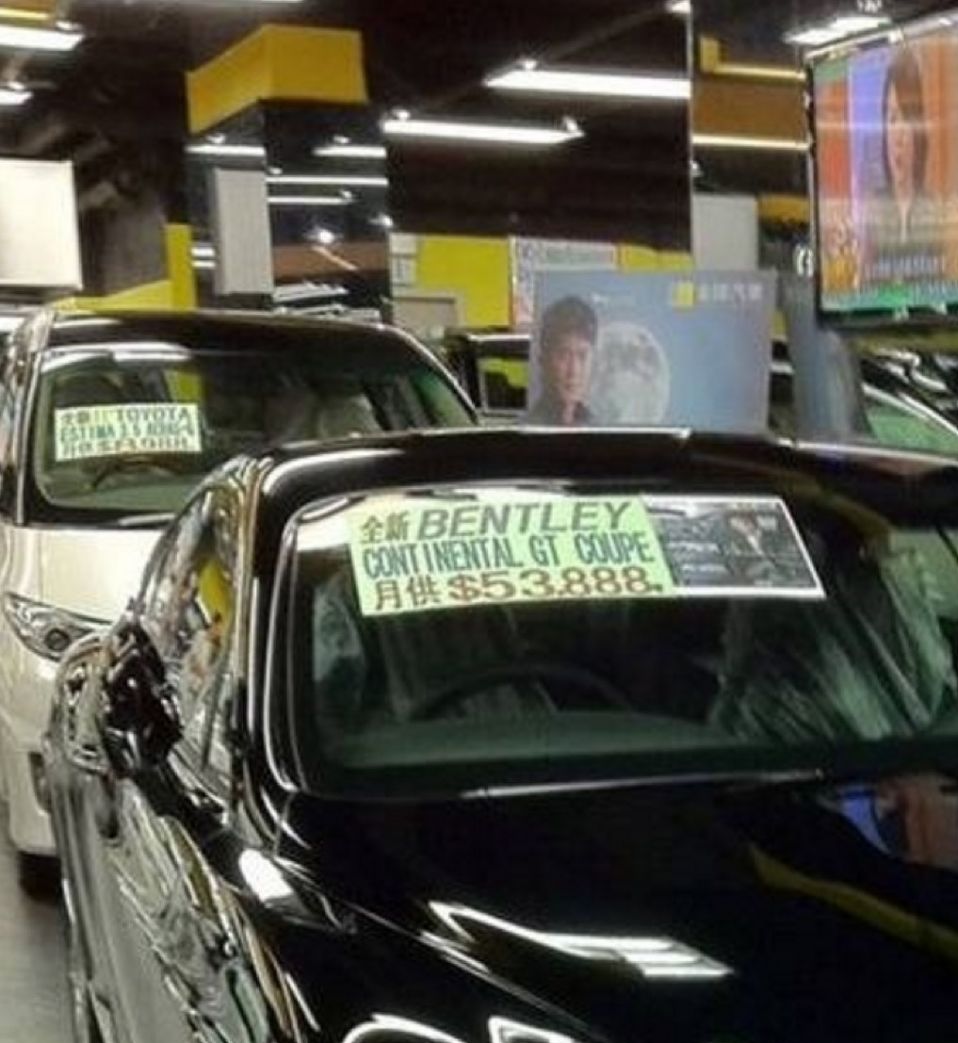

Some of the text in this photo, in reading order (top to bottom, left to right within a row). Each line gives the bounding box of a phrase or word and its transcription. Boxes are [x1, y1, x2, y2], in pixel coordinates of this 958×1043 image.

[360, 501, 632, 544] 全新 BENTLEY
[362, 535, 524, 580] CONTINENTAL
[529, 534, 562, 568] GT
[574, 530, 655, 565] COUPE
[375, 574, 442, 611] 月供
